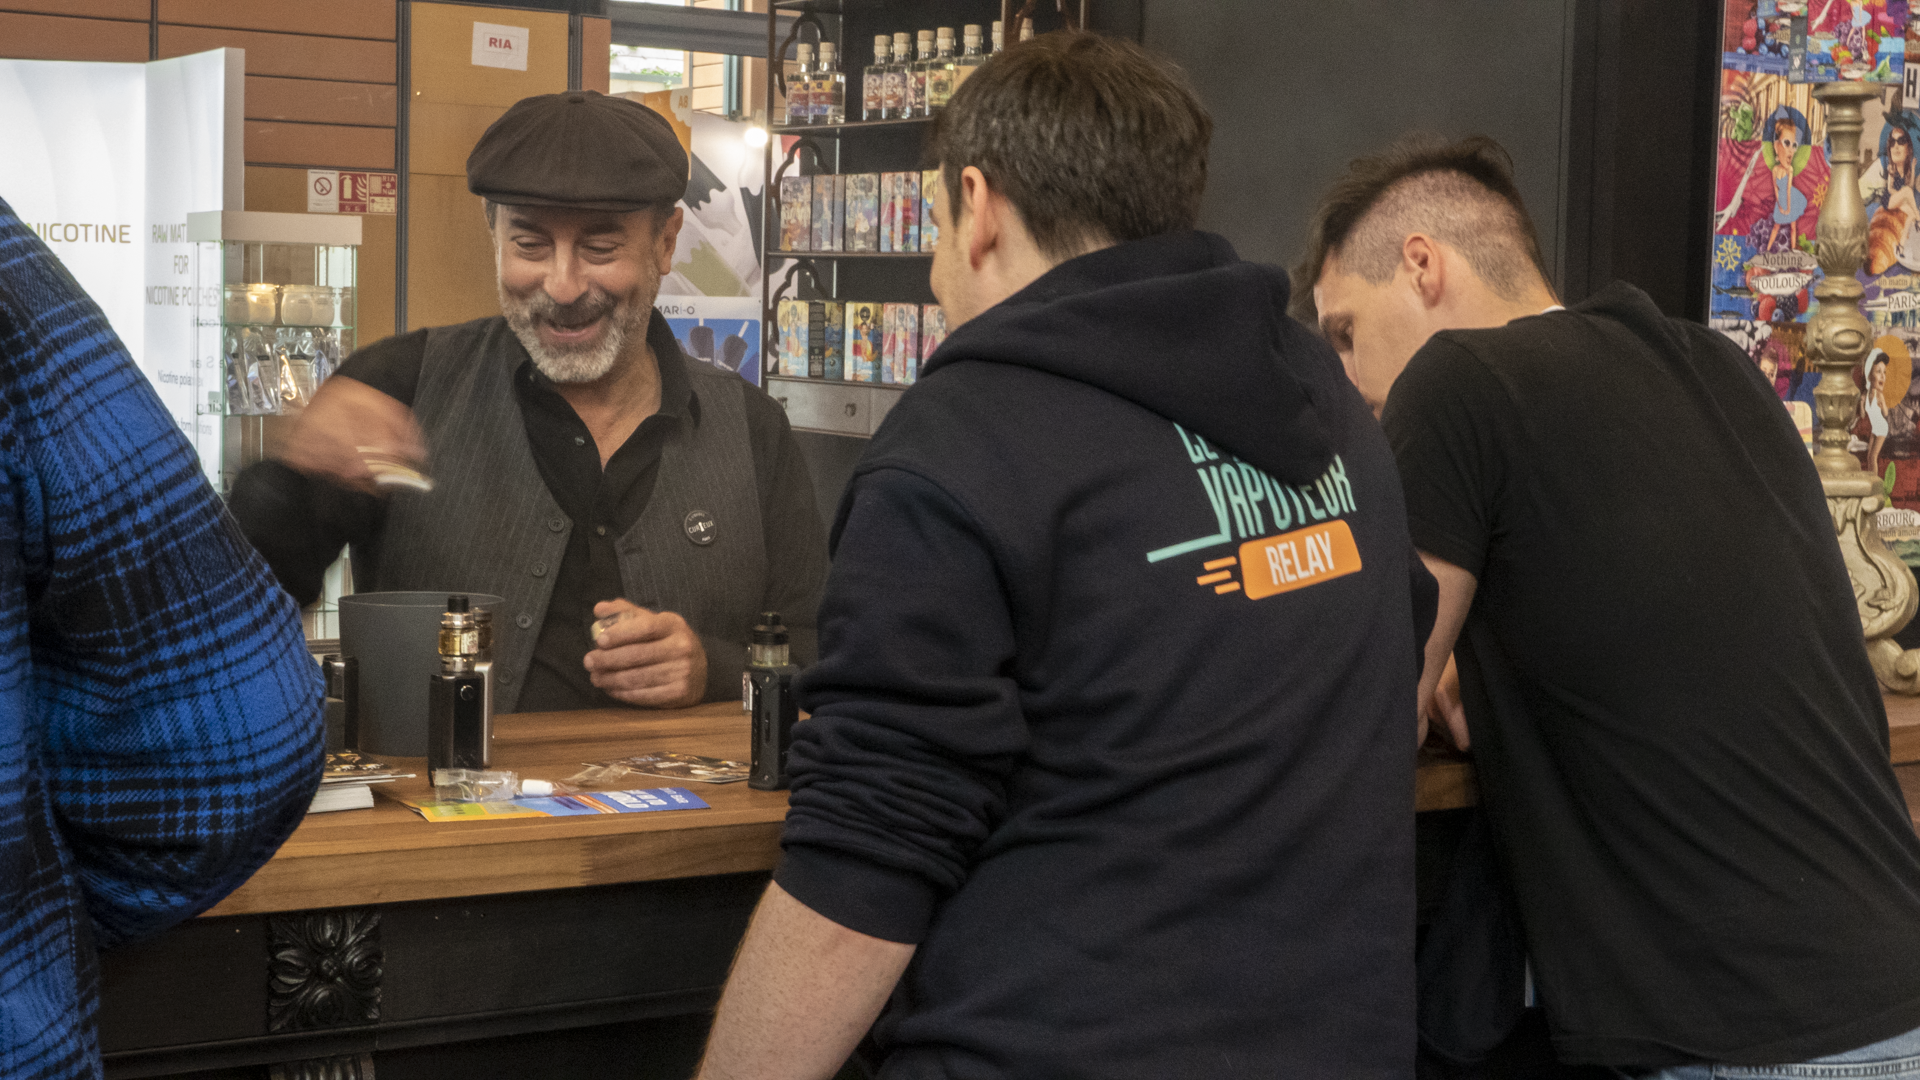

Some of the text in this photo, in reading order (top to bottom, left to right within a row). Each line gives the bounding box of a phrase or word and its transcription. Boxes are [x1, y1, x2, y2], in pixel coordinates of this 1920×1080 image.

[489, 37, 512, 50] RIA
[152, 224, 168, 243] RAW
[174, 254, 189, 275] FOR
[1762, 251, 1803, 267] Nothing
[1754, 275, 1807, 289] TOULOUSE
[146, 285, 180, 306] NICOTINE
[1888, 294, 1918, 309] PARIS
[1265, 530, 1336, 587] RELAY
